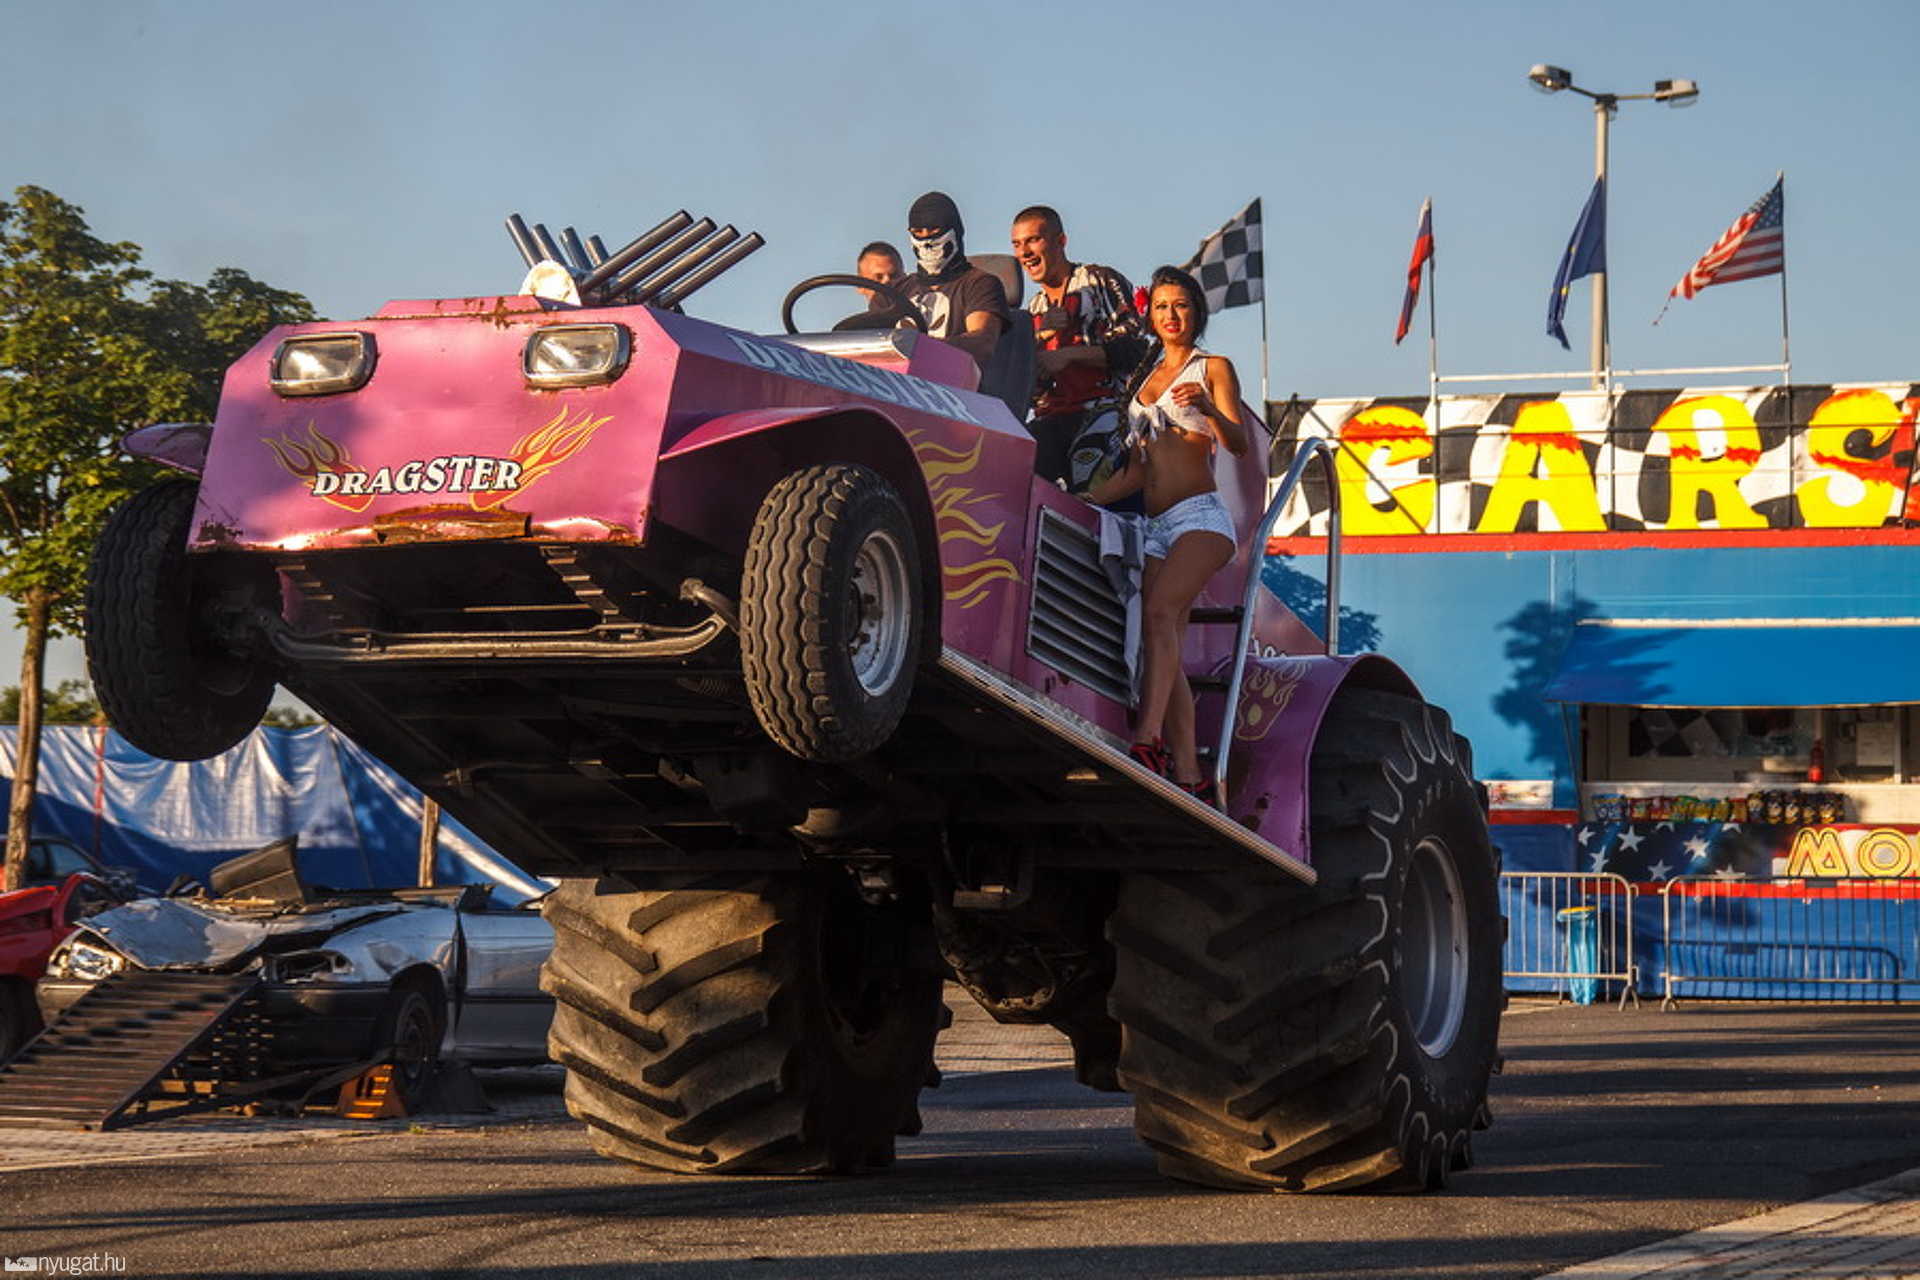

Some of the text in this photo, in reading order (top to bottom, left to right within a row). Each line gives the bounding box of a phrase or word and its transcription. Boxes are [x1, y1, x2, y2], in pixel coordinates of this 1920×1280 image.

[725, 331, 983, 426] DRAGSTER
[312, 455, 522, 496] DRAGSTER
[1335, 388, 1905, 537] CARS
[1786, 827, 1920, 878] MO
